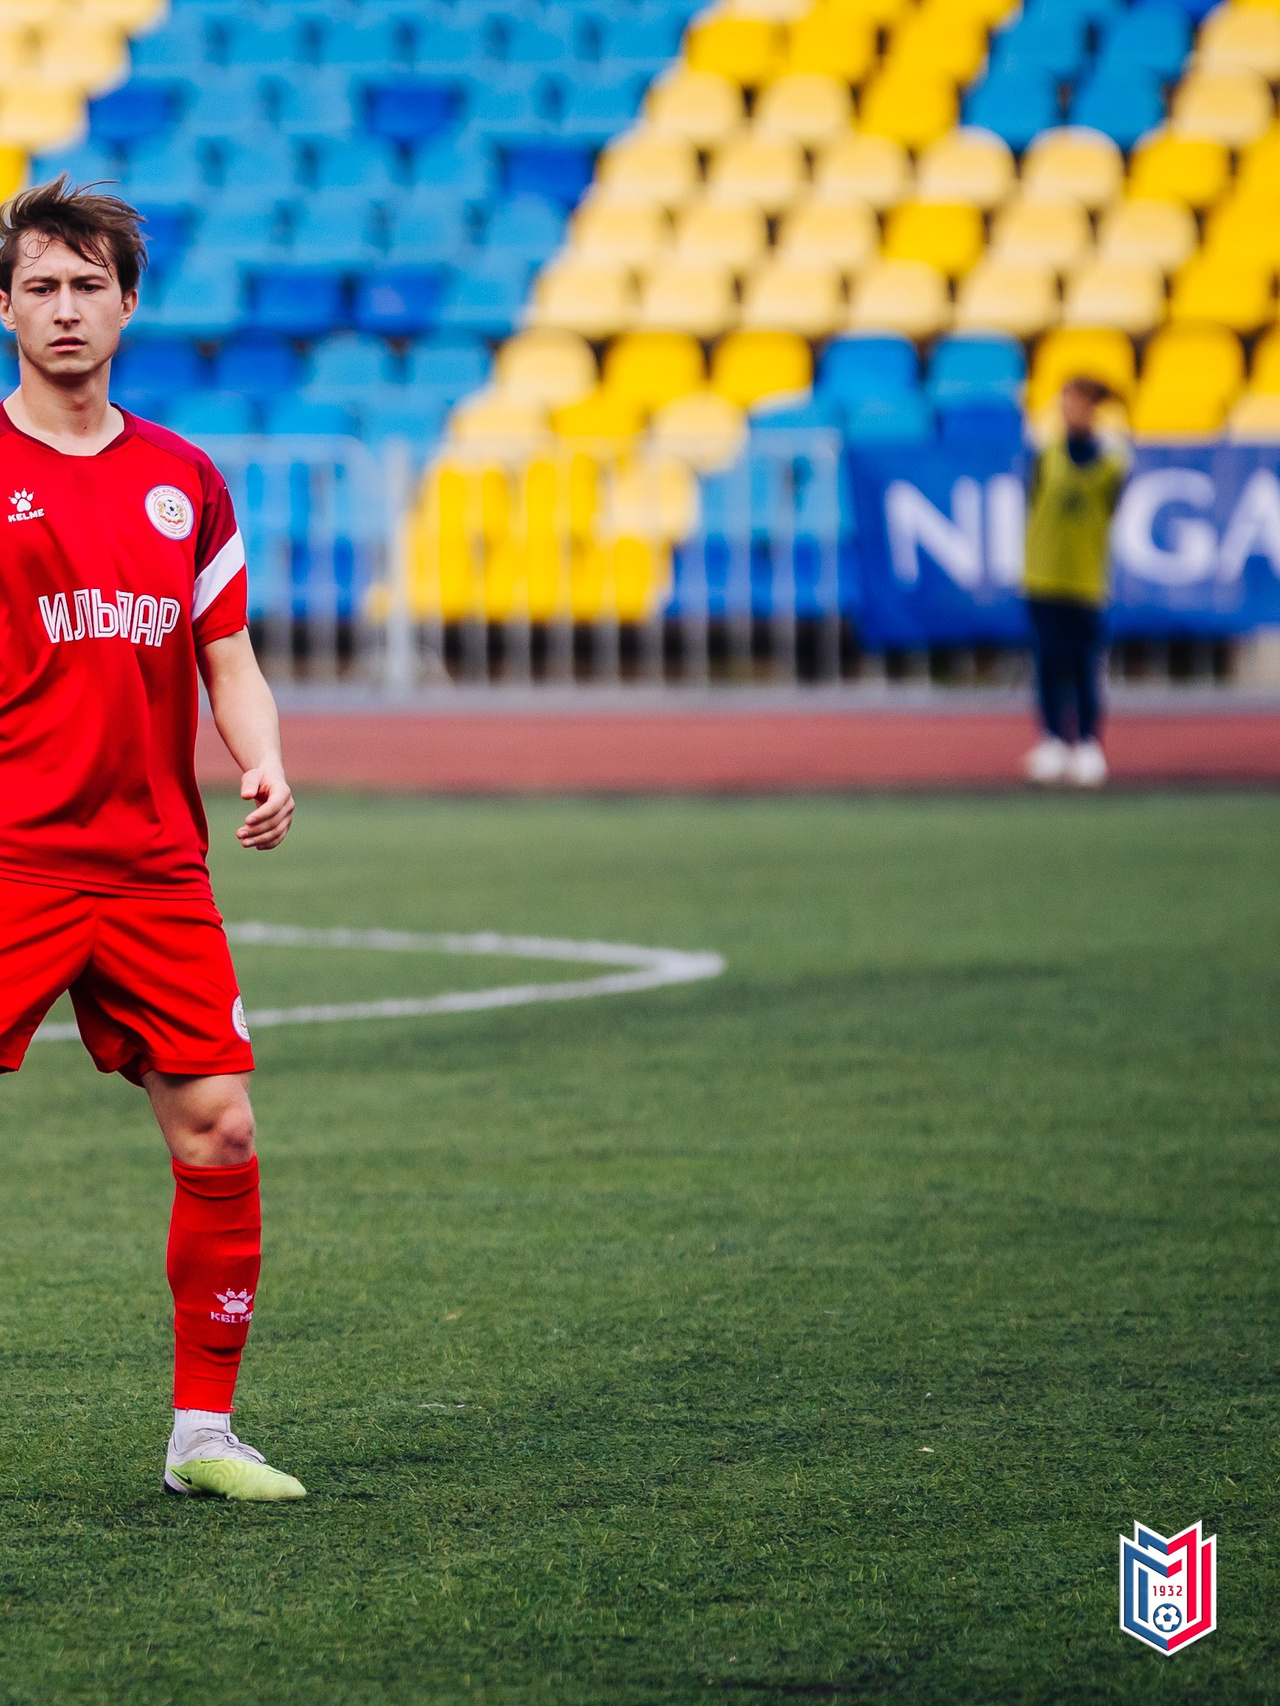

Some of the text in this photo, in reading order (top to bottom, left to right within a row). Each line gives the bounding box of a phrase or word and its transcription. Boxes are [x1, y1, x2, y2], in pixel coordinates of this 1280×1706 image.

[7, 508, 45, 523] KELME
[884, 467, 1280, 590] NIGA
[37, 588, 181, 648] ИЛЬПАР
